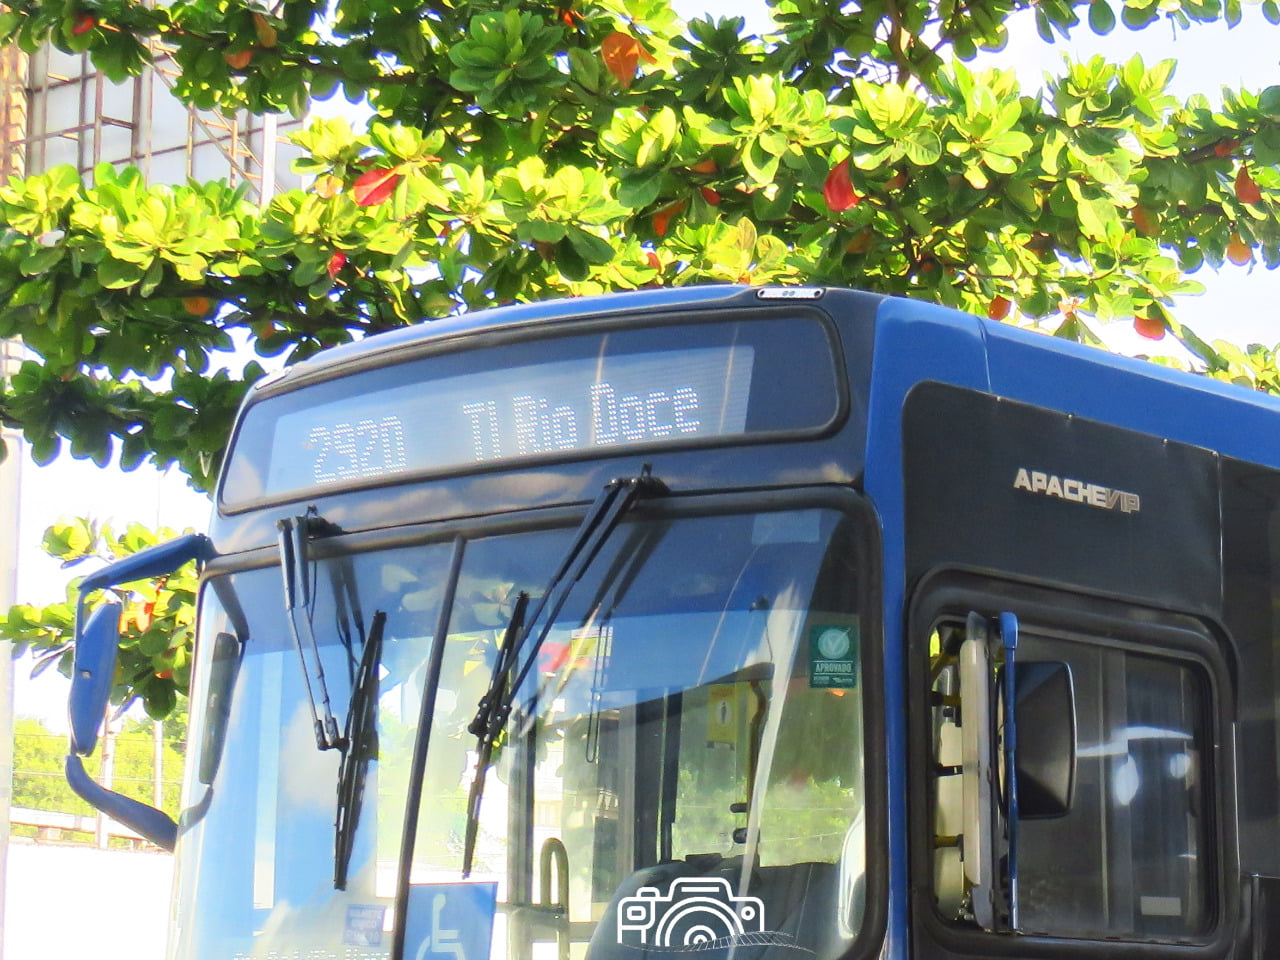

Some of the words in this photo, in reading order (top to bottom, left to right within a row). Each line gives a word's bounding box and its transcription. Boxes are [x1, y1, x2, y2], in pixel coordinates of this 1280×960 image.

[309, 415, 407, 484] 2920
[513, 394, 577, 455] Rio
[590, 381, 700, 446] Doce
[816, 663, 852, 673] APROVADO
